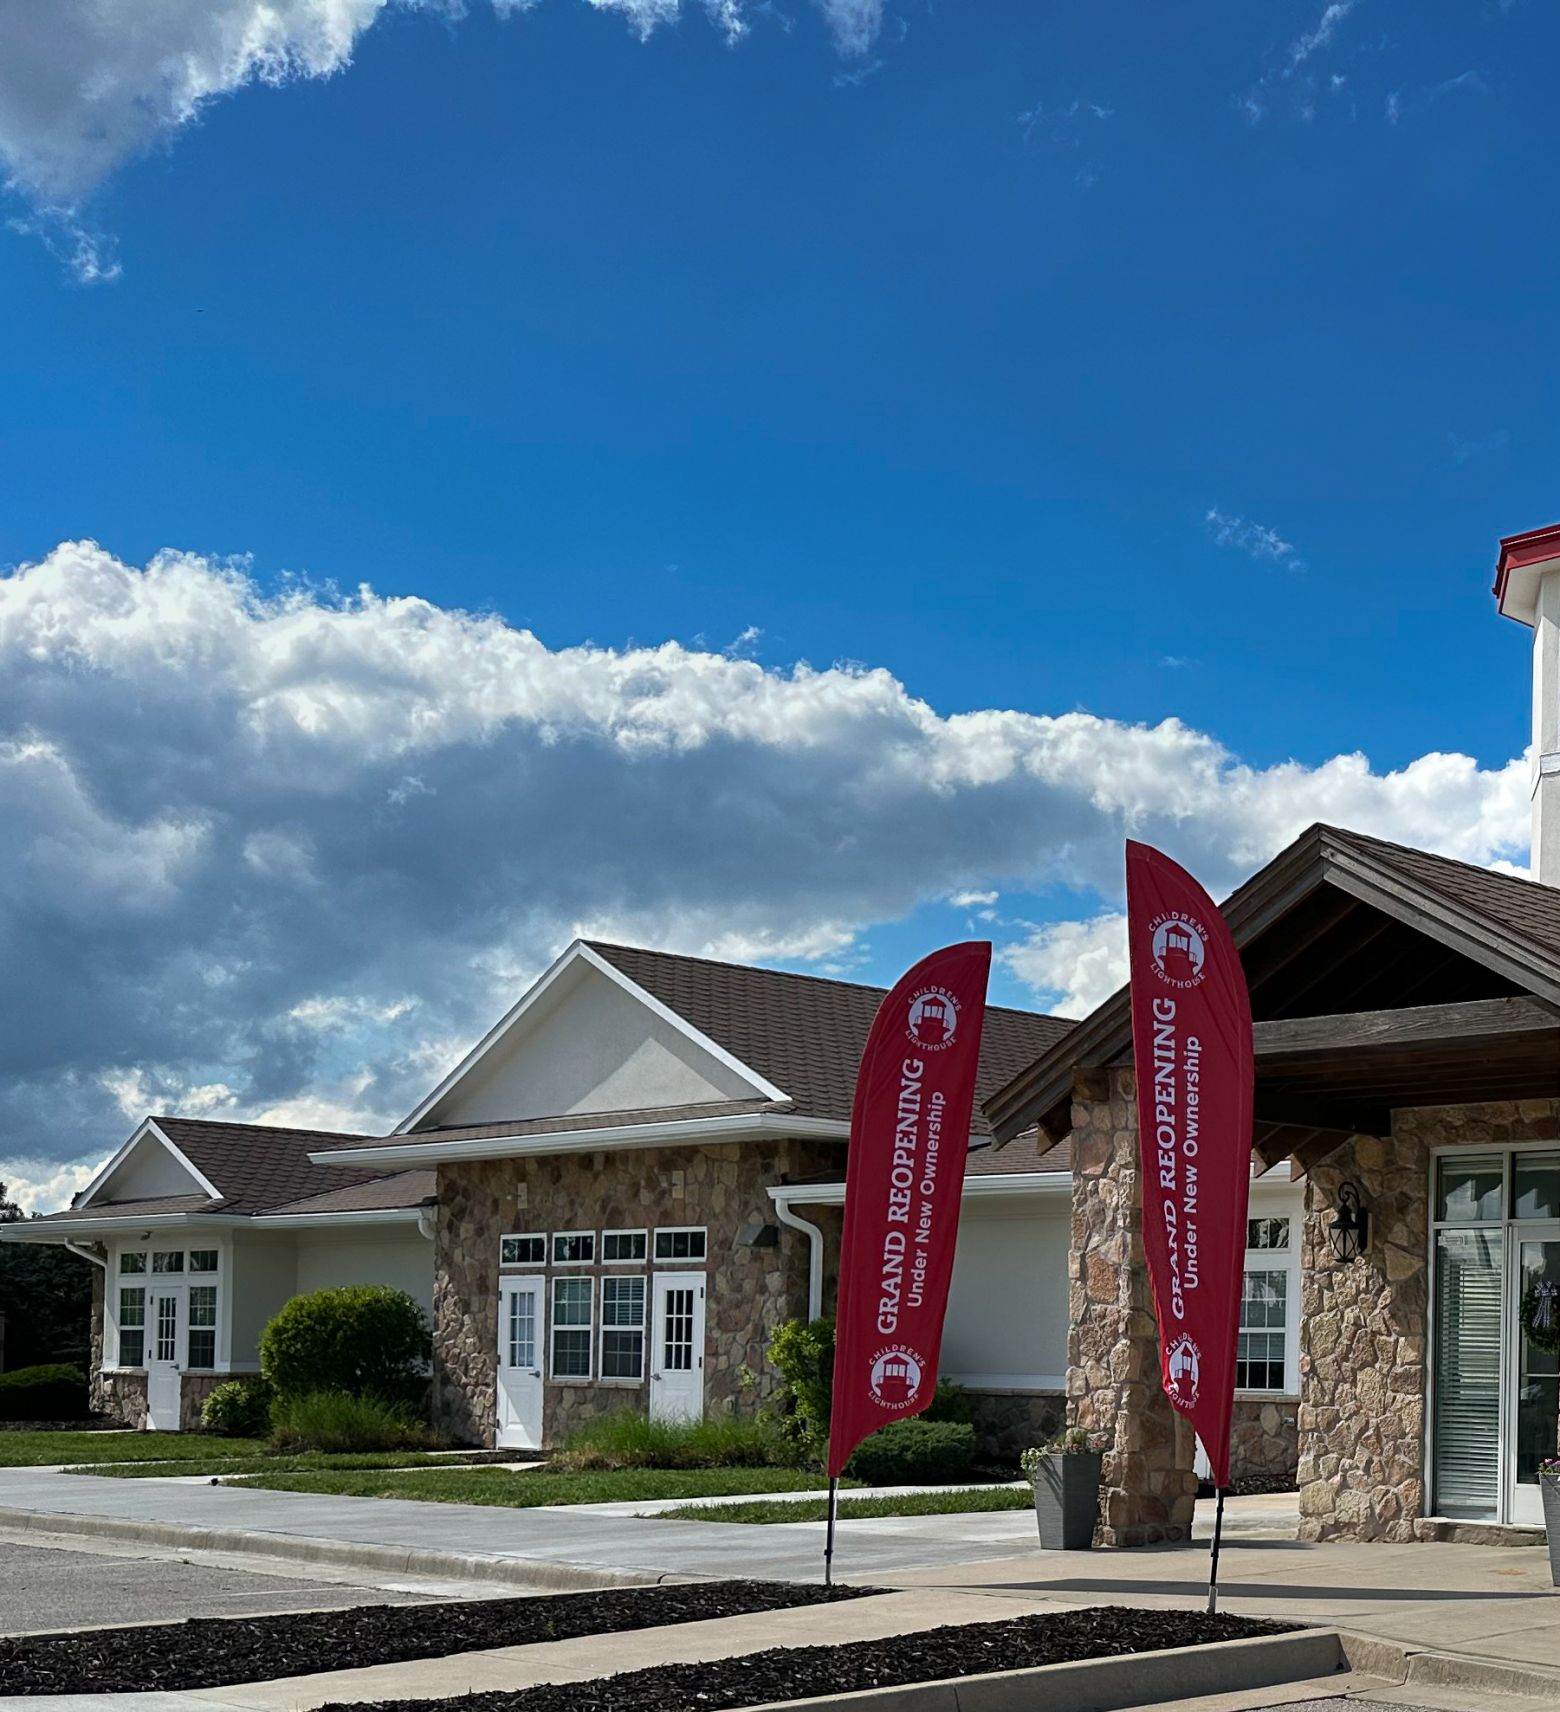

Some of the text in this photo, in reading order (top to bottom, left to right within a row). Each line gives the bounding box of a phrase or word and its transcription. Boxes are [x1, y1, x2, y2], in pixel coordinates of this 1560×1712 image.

[1148, 911, 1209, 942] CHILDREN'S
[907, 985, 962, 1012] CHILDREN'S
[905, 1029, 957, 1051] LIGHTHOUSE
[1152, 997, 1185, 1320] GRAND REOPENING
[1183, 1036, 1202, 1289] Under New Ownership
[877, 1058, 924, 1335] GRAND REOPENING
[907, 1091, 946, 1307] Under New Ownership
[868, 1344, 926, 1368] CHILDREN'S
[1165, 1332, 1202, 1360] CHLDN'S
